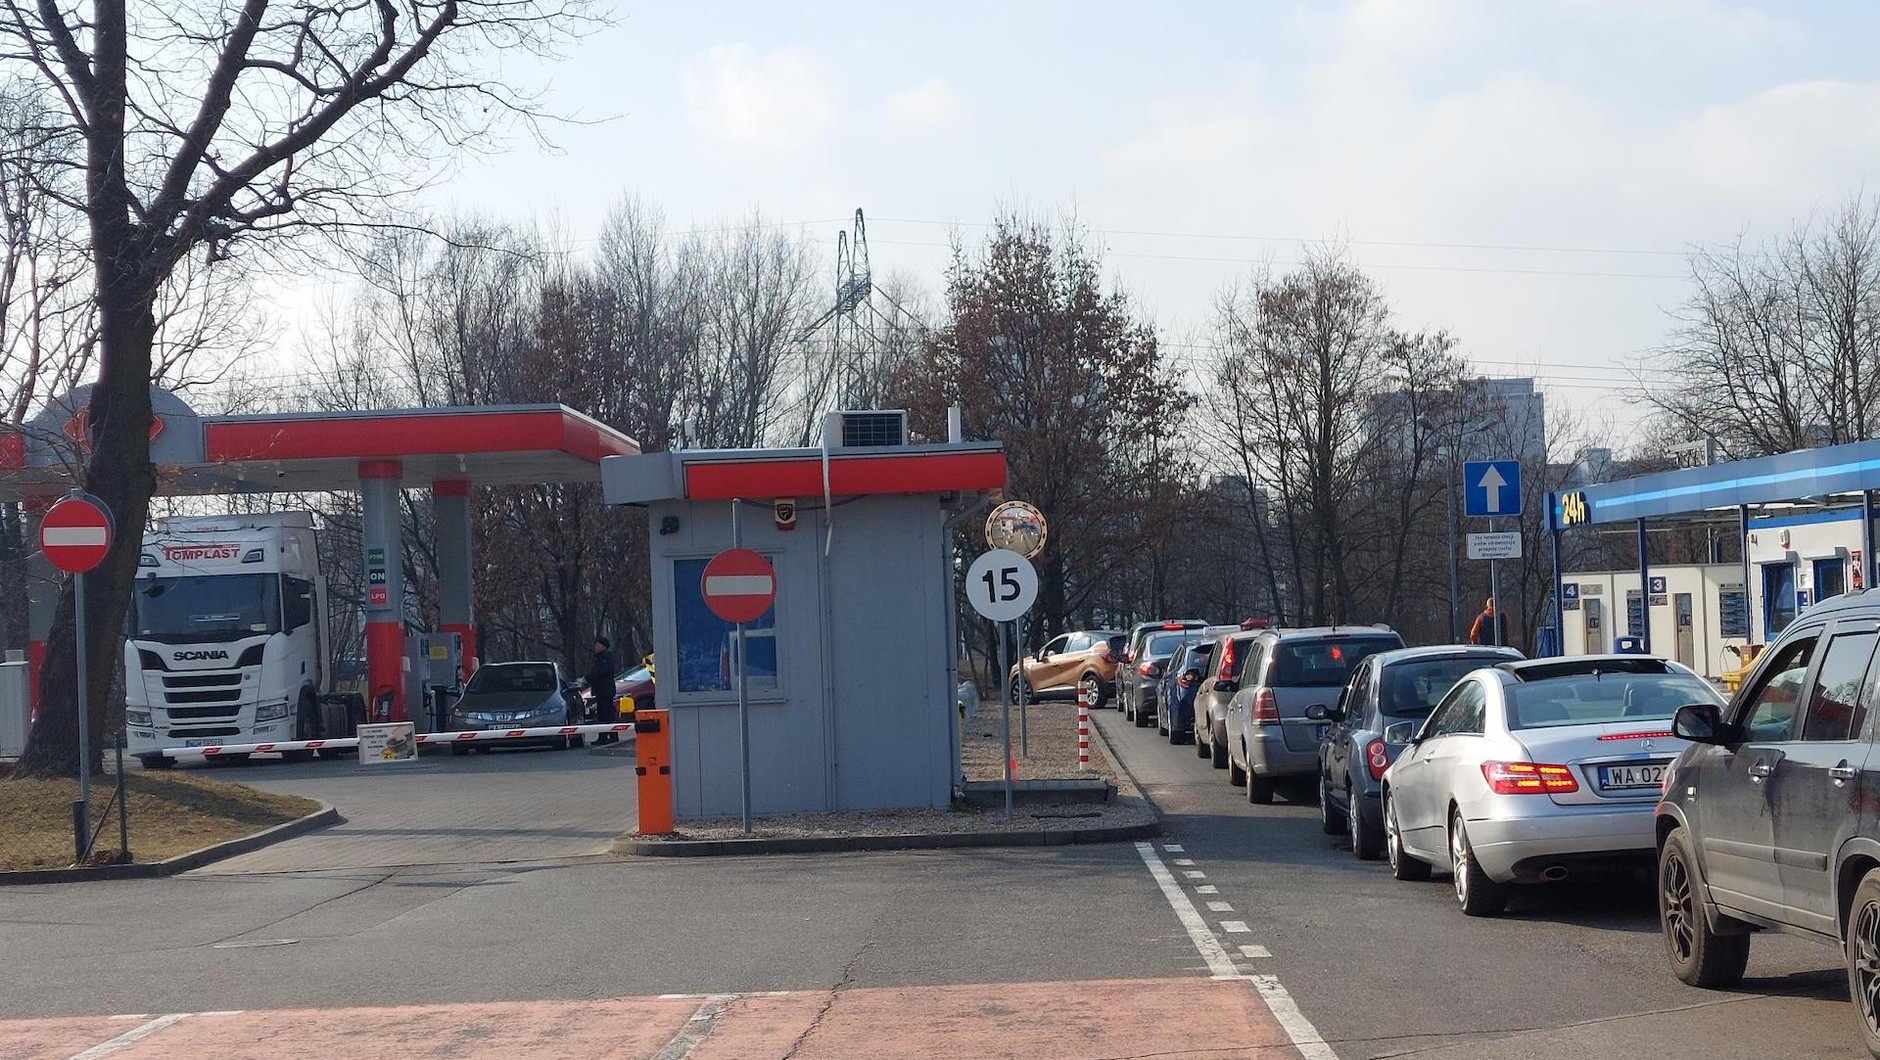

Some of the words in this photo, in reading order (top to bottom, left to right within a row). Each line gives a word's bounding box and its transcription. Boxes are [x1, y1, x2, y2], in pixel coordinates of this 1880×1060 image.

[1562, 491, 1585, 524] 24h
[164, 543, 241, 561] TOMPLAST
[370, 572, 385, 581] ON
[982, 567, 1021, 603] 15
[1566, 585, 1576, 597] 4
[1653, 579, 1663, 591] 3
[173, 650, 229, 661] SCANIA
[1612, 768, 1635, 784] WA
[1641, 766, 1667, 783] 02
